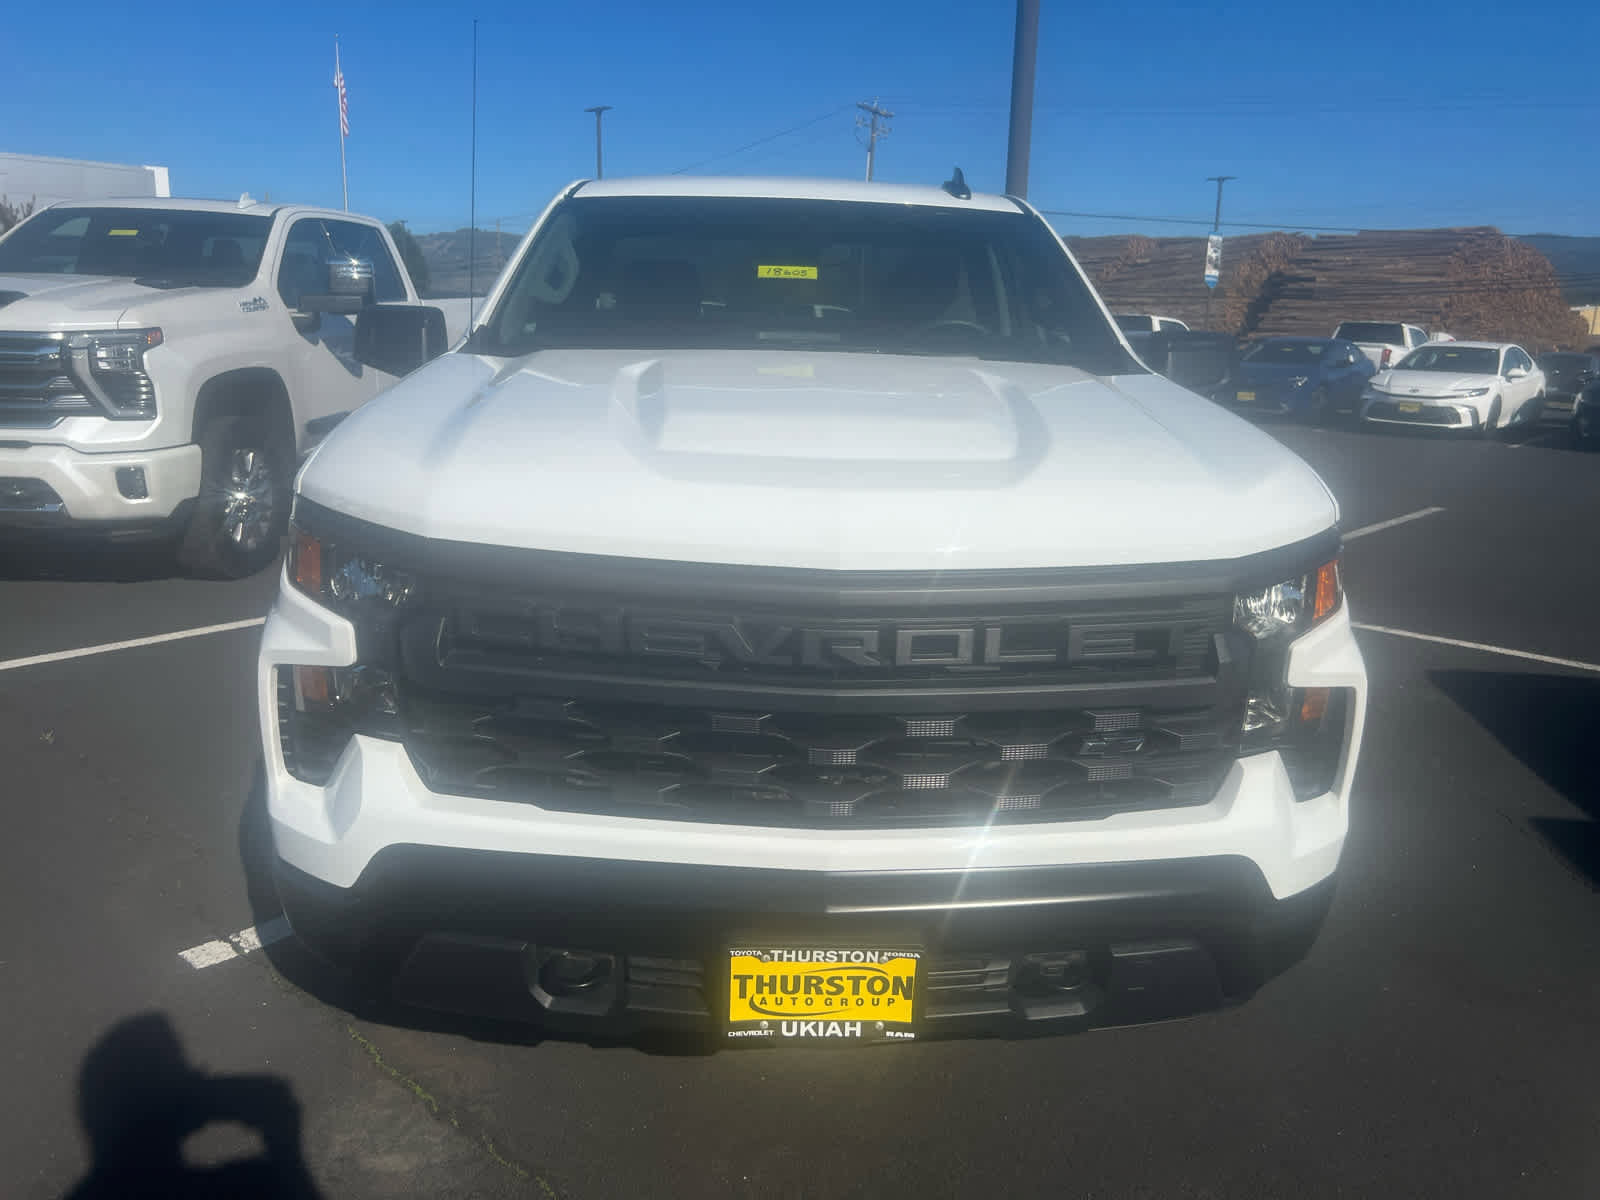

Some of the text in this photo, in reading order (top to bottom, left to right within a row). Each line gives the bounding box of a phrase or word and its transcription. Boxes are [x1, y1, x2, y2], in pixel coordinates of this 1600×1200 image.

[450, 604, 1213, 669] CHEVROLET
[770, 950, 879, 963] THURSTON
[733, 974, 913, 1001] THURSTON
[759, 996, 896, 1007] AUTO GROUP
[781, 1021, 861, 1037] UKIAH
